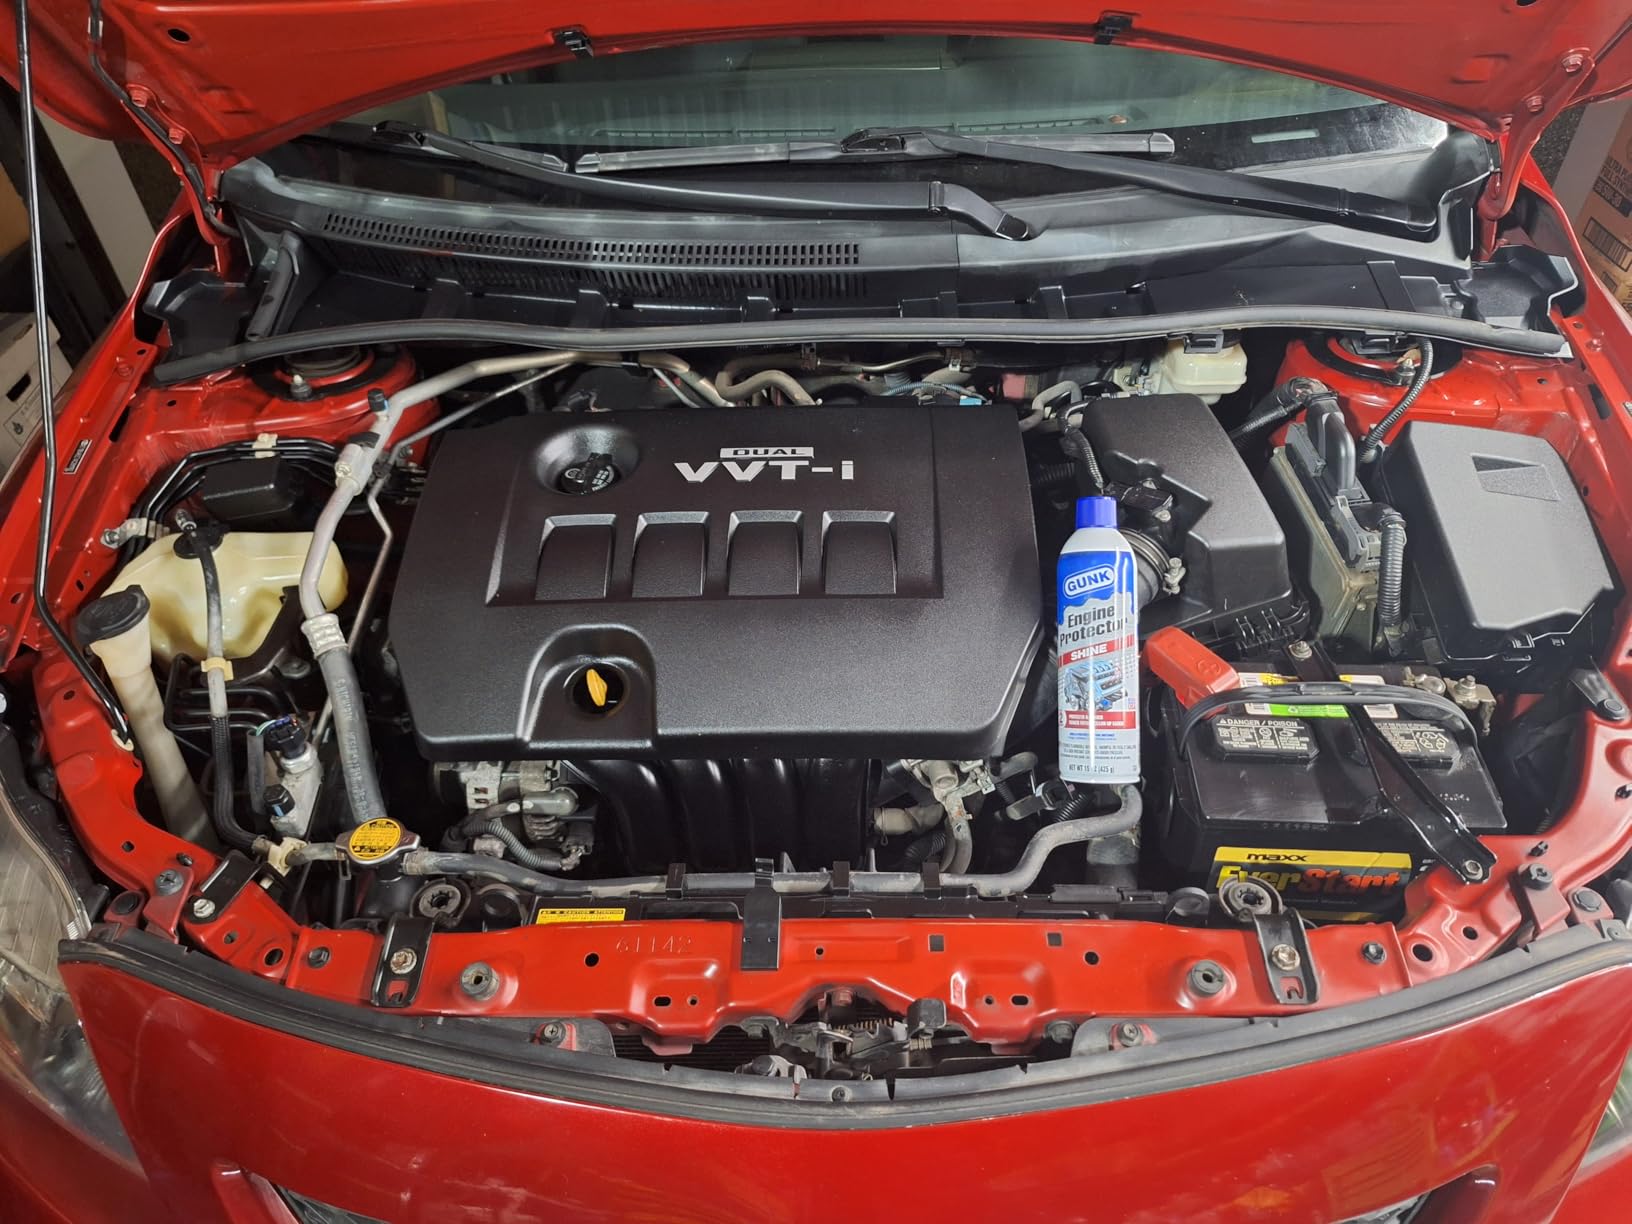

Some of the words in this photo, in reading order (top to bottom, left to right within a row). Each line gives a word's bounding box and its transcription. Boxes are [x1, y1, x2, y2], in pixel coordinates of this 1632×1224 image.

[732, 448, 806, 456] DUAL
[673, 460, 854, 482] VVT-i
[1067, 570, 1111, 592] GUNK
[1067, 605, 1116, 629] Engine
[1070, 643, 1108, 661] SHINE
[1227, 718, 1260, 726] DANGER
[1267, 720, 1298, 728] POISON
[1247, 853, 1307, 862] maxx
[615, 935, 692, 953] 61142
